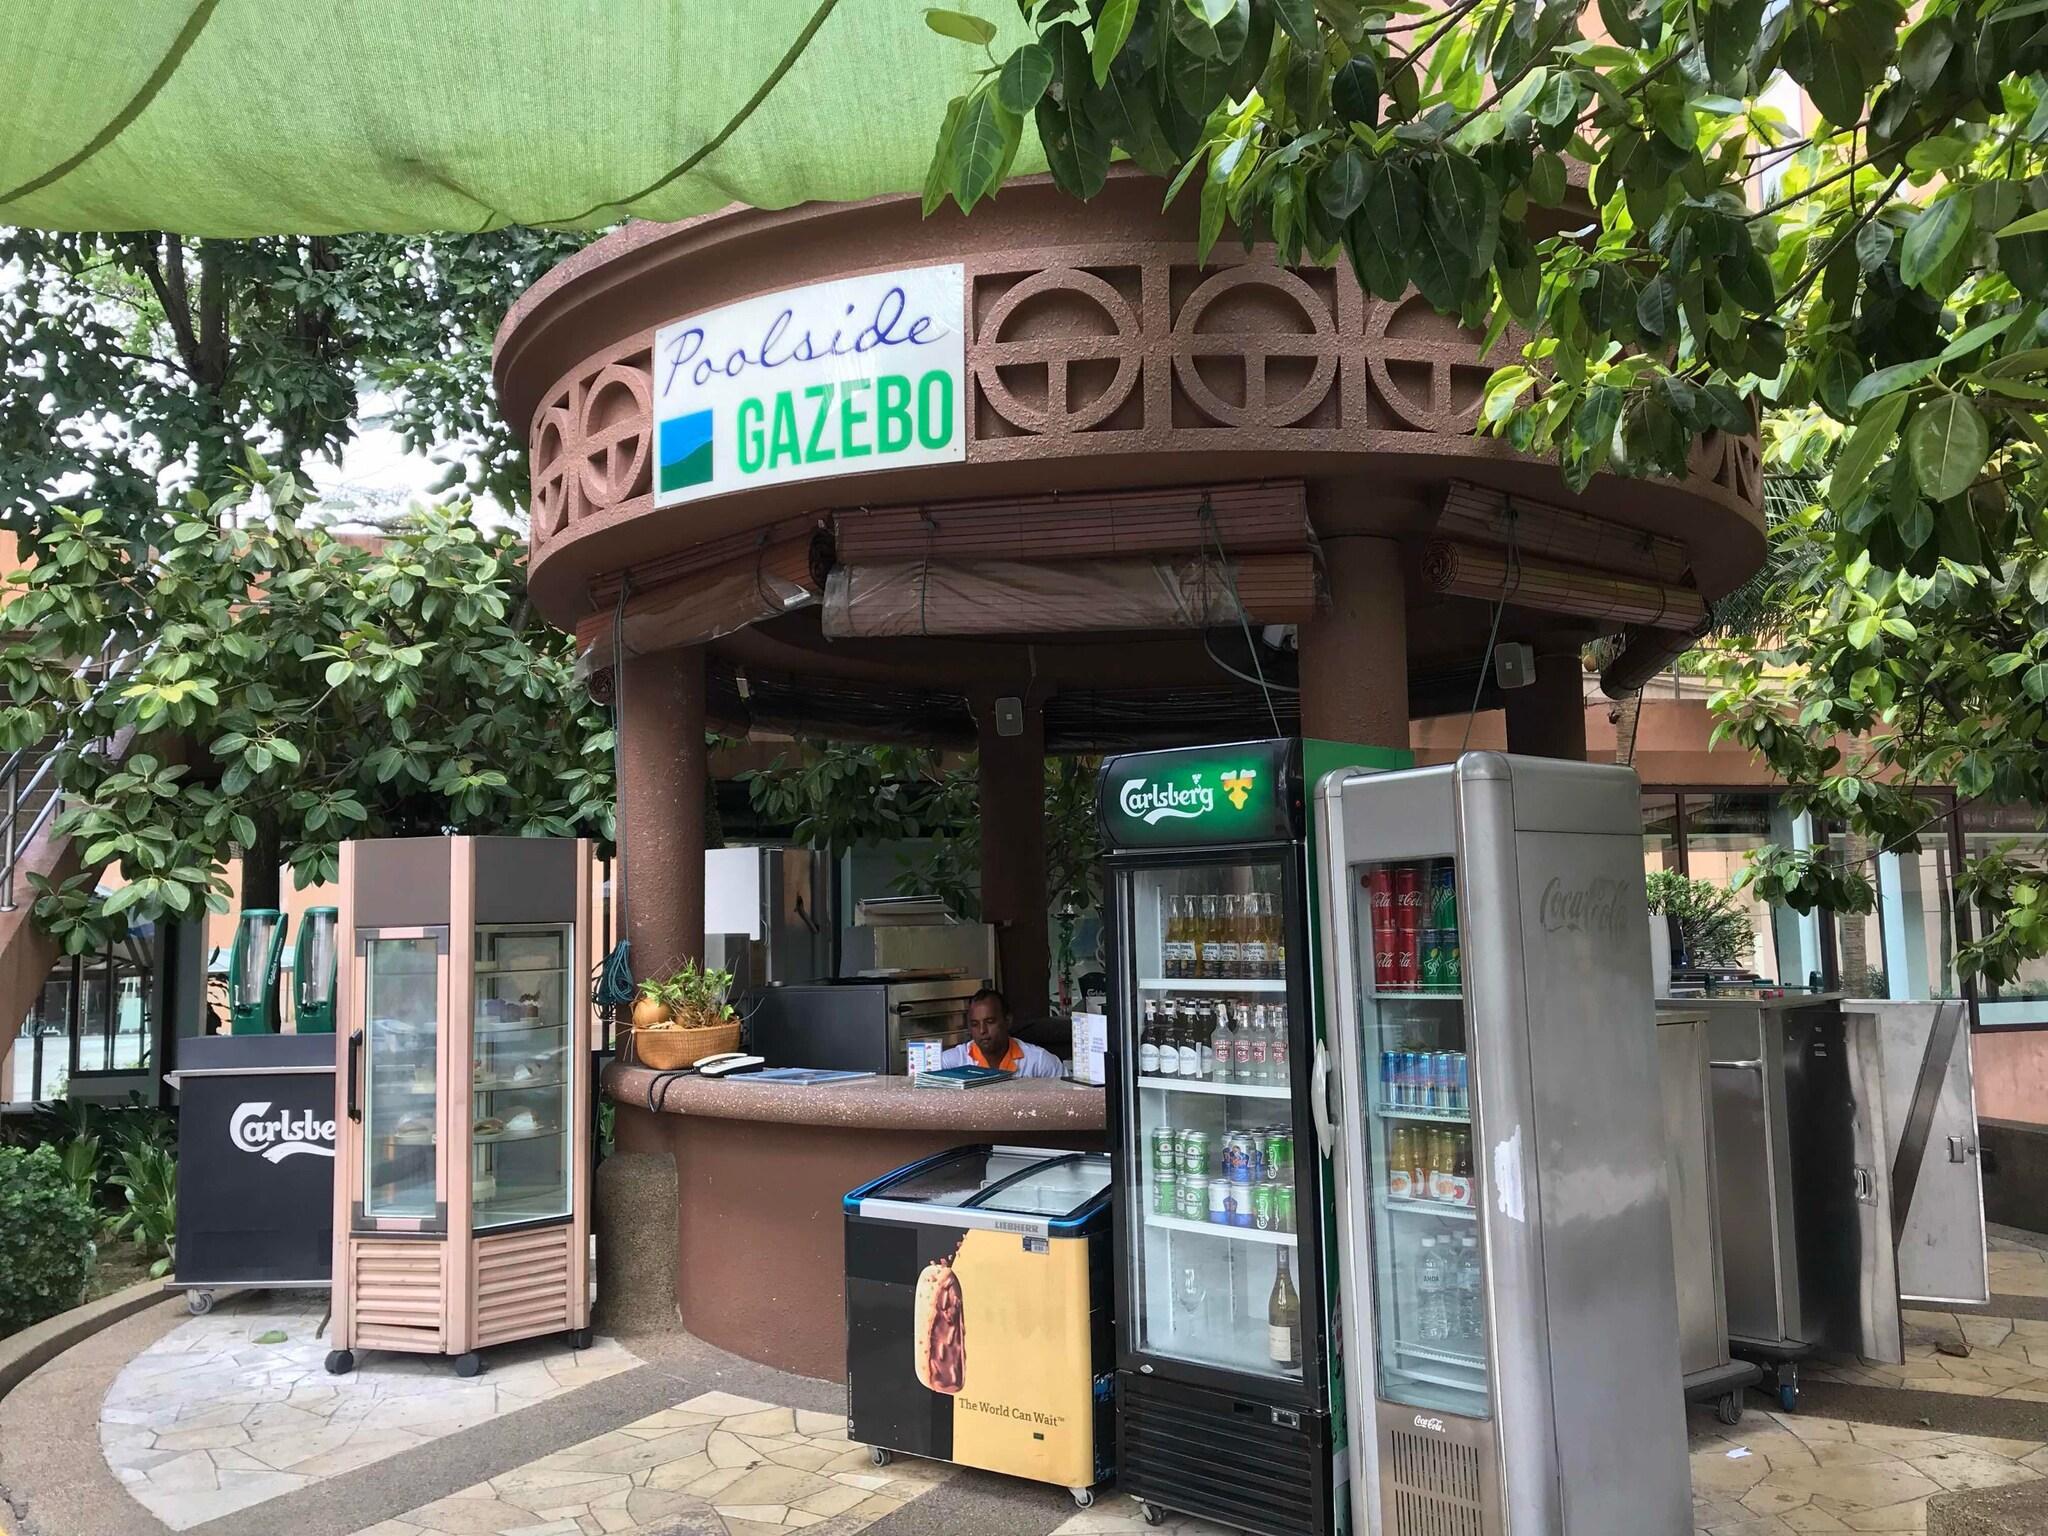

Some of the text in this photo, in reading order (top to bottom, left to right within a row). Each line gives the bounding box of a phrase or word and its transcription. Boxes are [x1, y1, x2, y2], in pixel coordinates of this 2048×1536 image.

[663, 287, 951, 397] Poolside
[736, 369, 953, 474] GAZEBO
[1120, 774, 1214, 824] Carlsberg
[994, 1221, 1039, 1233] LIEBHERR
[959, 1398, 978, 1411] The
[979, 1401, 1010, 1418] World
[1012, 1408, 1032, 1422] Can
